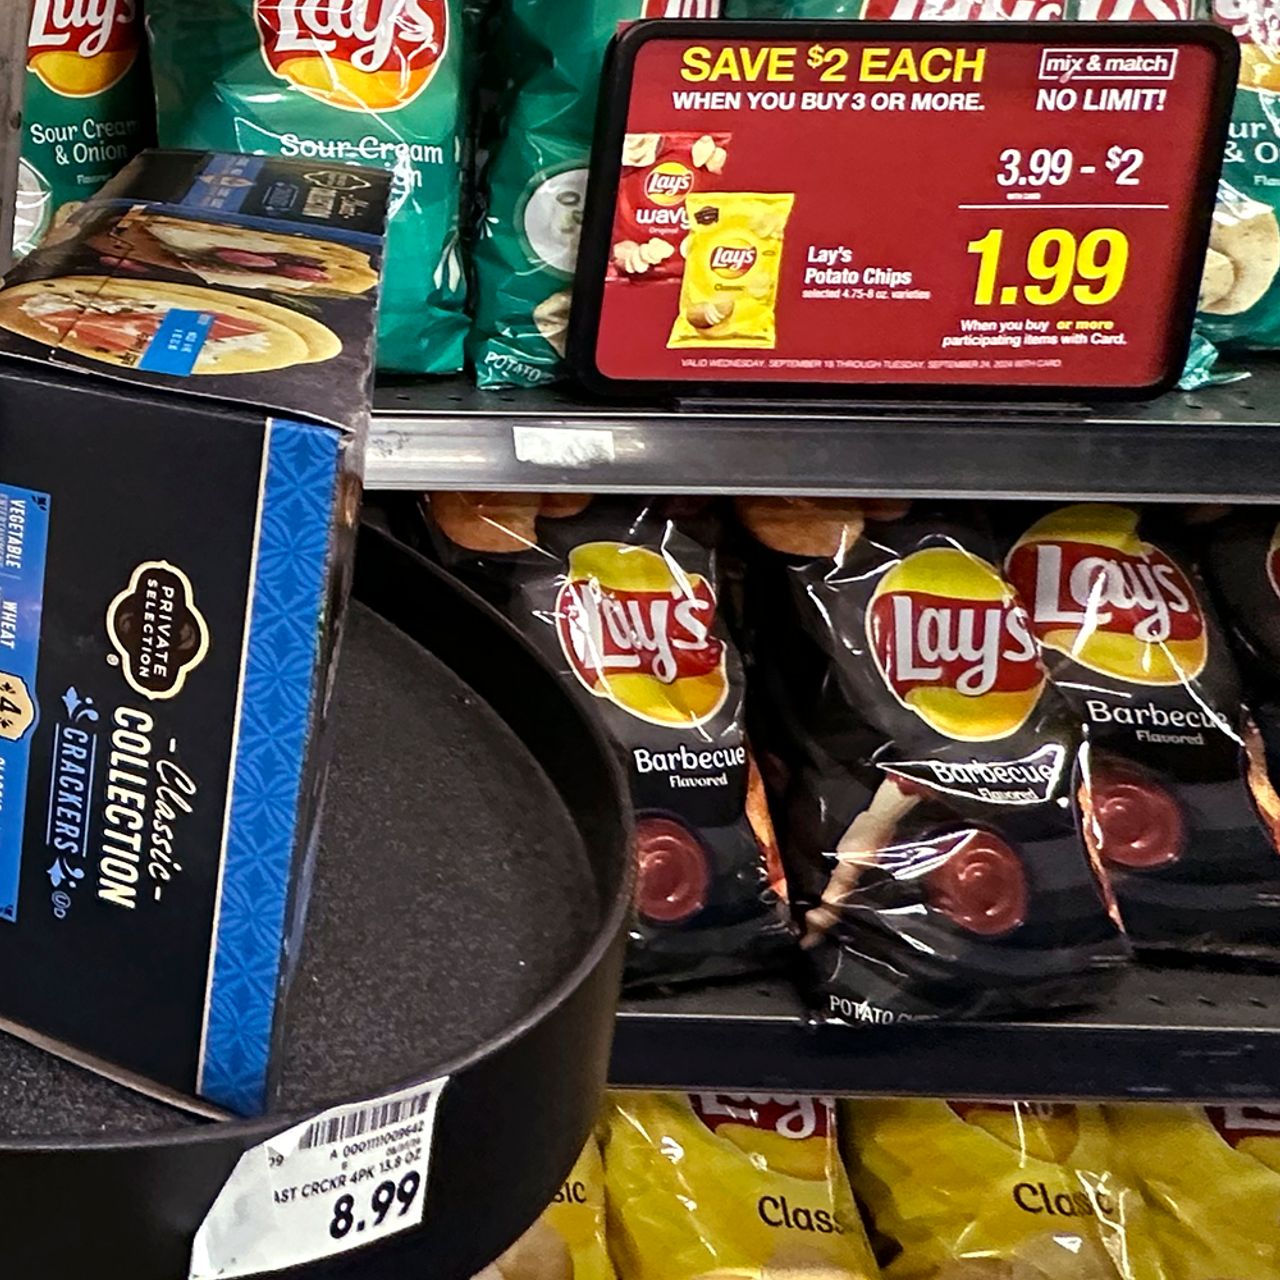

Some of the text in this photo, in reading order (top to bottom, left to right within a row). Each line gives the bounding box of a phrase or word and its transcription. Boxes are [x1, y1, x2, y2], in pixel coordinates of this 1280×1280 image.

[680, 43, 986, 83] SAVE $2 EACH
[1046, 54, 1168, 73] mix & match
[672, 92, 987, 111] WHEN YOU BUY 3 OR MORE.
[1036, 88, 1168, 111] NO LIMIT!
[54, 141, 128, 166] & Onion
[280, 132, 443, 166] Sour Cream
[996, 148, 1073, 187] 3.99
[1105, 145, 1144, 186] $2
[807, 245, 853, 265] Lay's
[967, 227, 1130, 306] 1.99
[803, 267, 913, 287] Potato Chips
[942, 334, 1022, 348] participating
[1023, 333, 1059, 346] items
[1060, 332, 1090, 346] with
[960, 319, 1115, 334] When you buy or more
[6, 498, 28, 570] VEGETABLE
[1034, 544, 1192, 644] Lay's
[138, 576, 159, 679] SELECTION
[152, 584, 176, 679] PRIVATE
[893, 595, 1038, 697] Lay's
[1086, 700, 1228, 732] Barbecue
[1136, 728, 1205, 746] Flavored
[633, 743, 747, 776] Barbecue
[932, 758, 1054, 787] Barbecue
[54, 724, 90, 856] CRACKERS
[669, 772, 729, 789] Flavored
[97, 704, 155, 910] COLLECTION
[329, 1169, 422, 1240] 8.99
